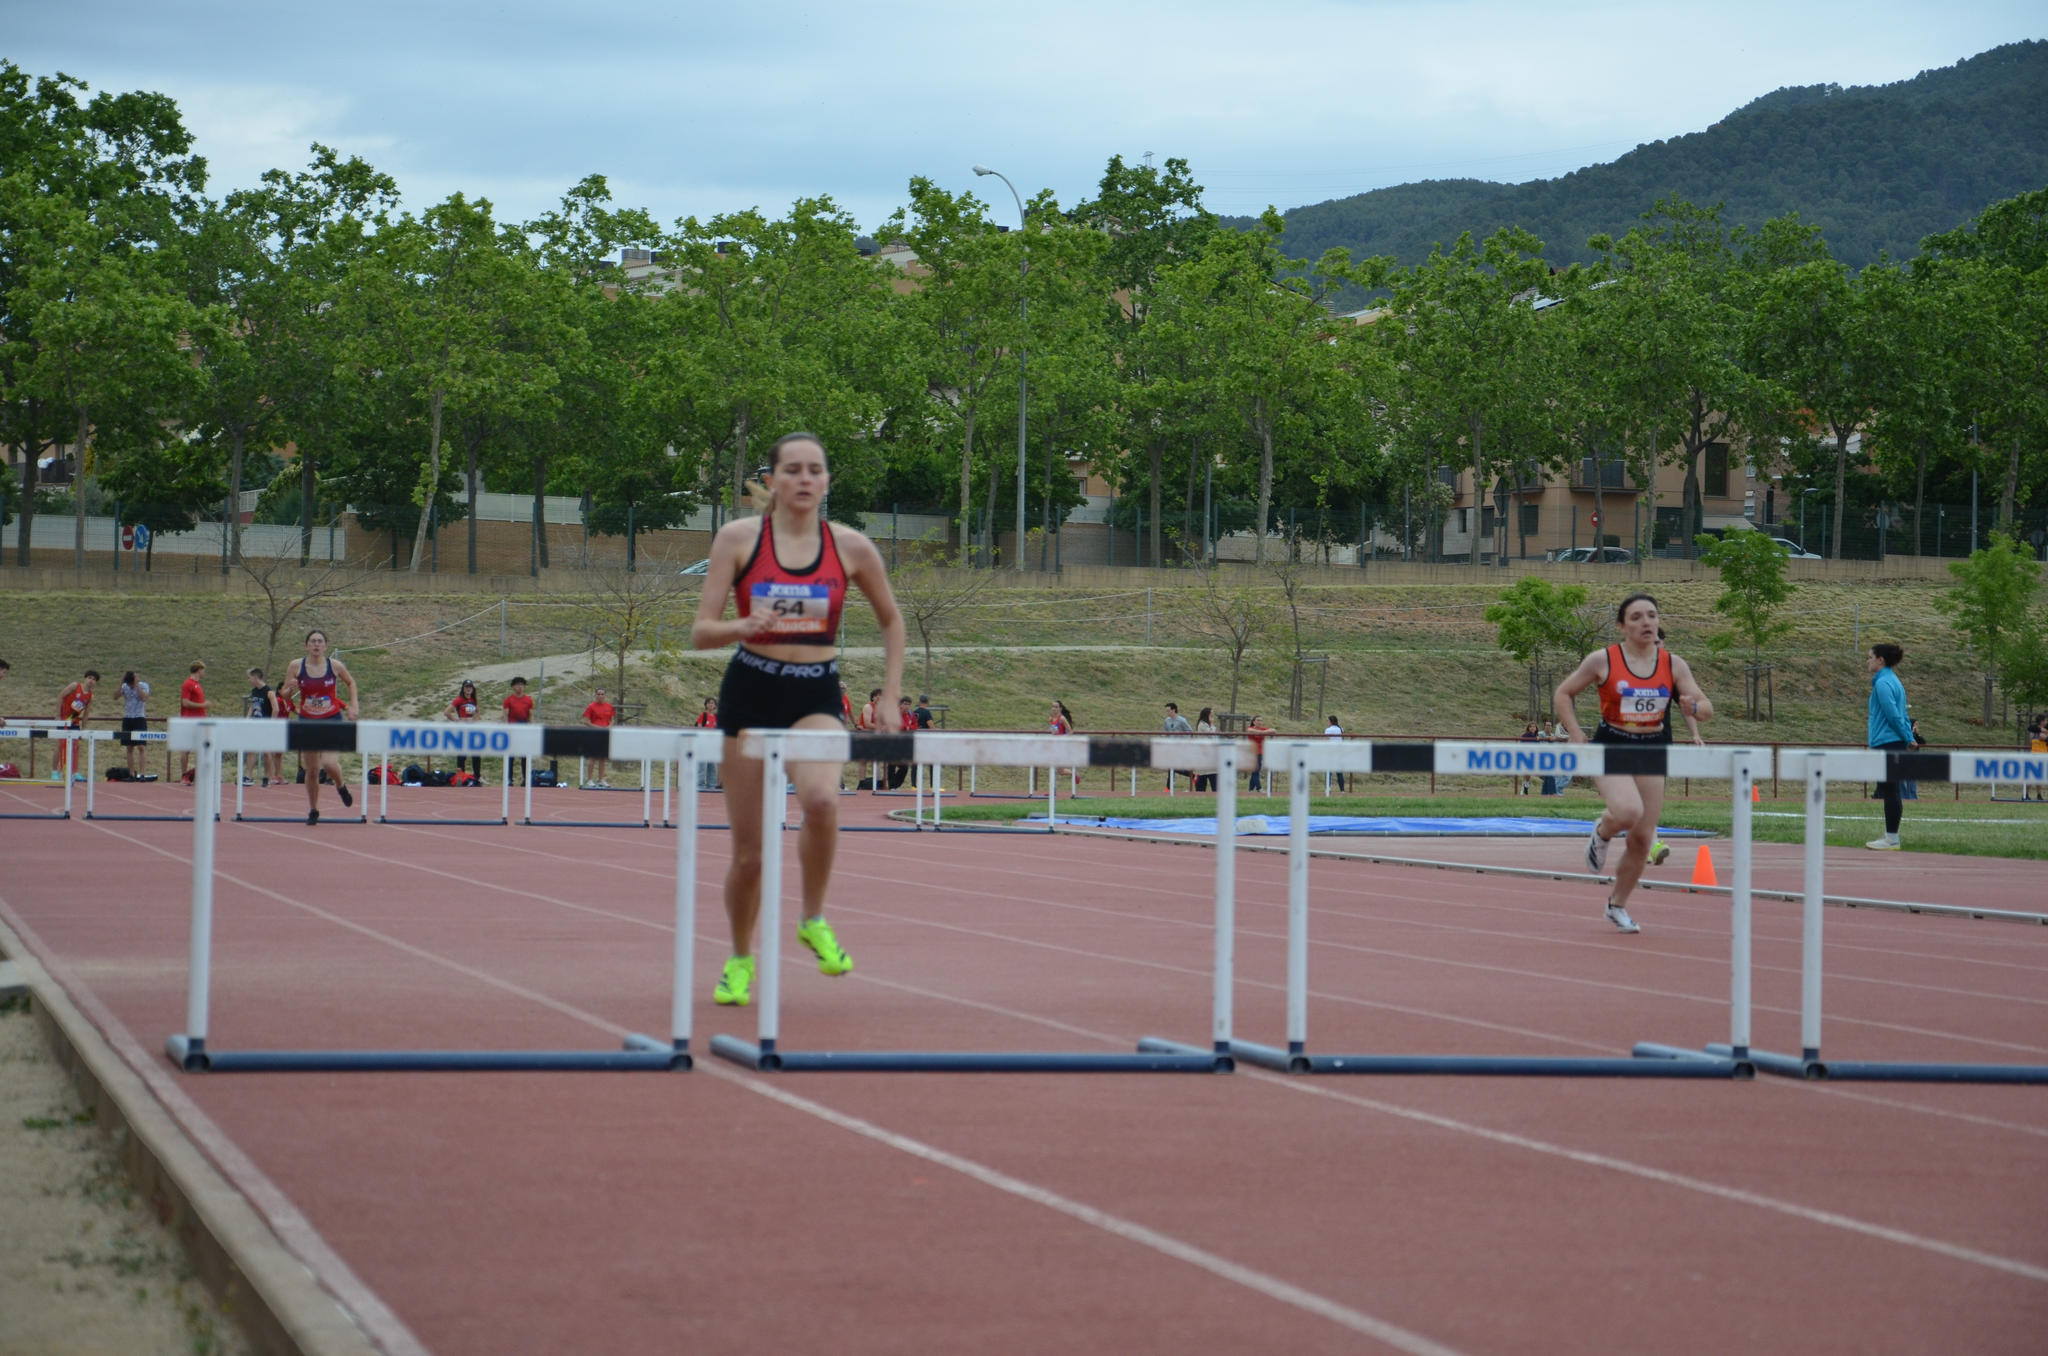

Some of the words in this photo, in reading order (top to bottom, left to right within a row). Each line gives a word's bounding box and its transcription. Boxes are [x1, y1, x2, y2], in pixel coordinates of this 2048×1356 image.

[737, 651, 780, 675] NIKE
[781, 664, 825, 679] PRO
[1635, 698, 1656, 713] 66
[390, 728, 510, 751] MONDO
[1467, 750, 1578, 771] MONDO
[1975, 758, 2048, 780] MON
